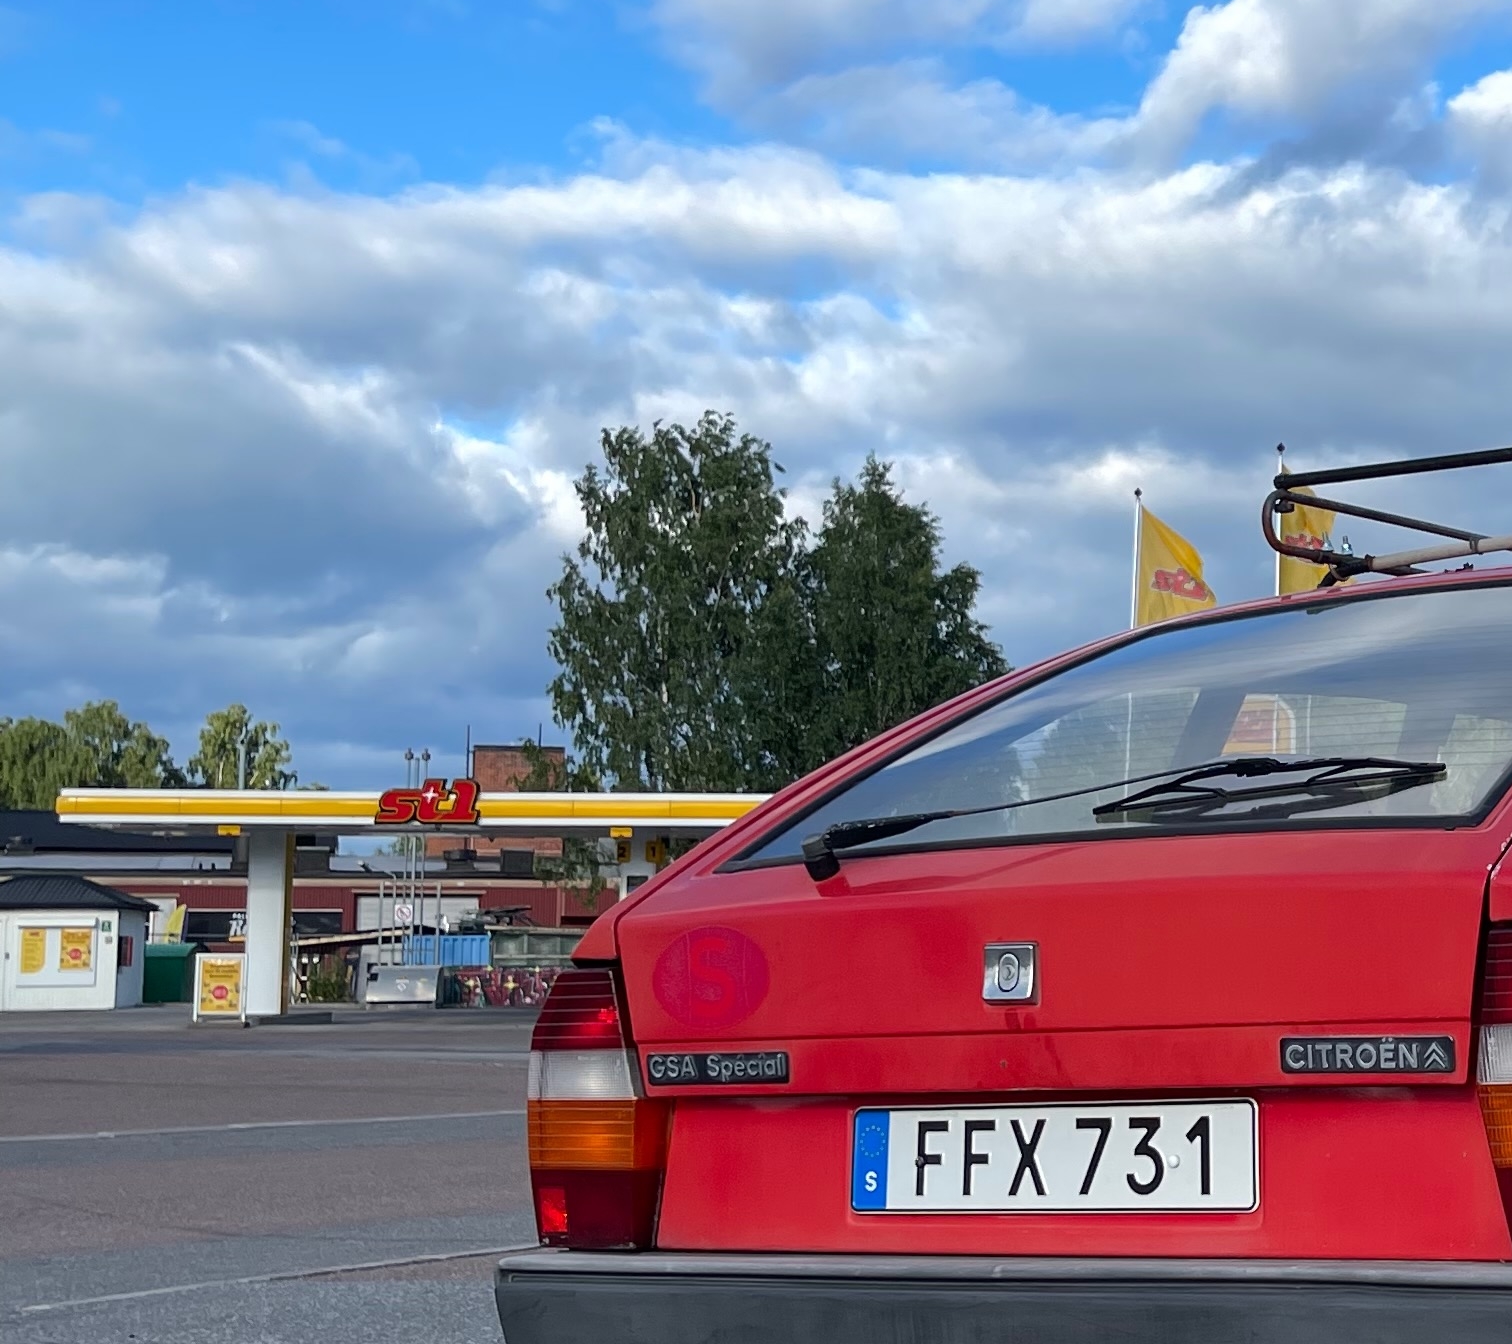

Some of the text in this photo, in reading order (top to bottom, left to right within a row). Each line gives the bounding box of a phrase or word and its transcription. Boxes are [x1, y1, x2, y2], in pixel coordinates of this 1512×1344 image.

[375, 778, 480, 824] st1
[689, 936, 736, 1018] S
[649, 1055, 697, 1078] GSA
[1285, 1037, 1419, 1069] CITROËN
[915, 1115, 1212, 1197] FFX 731
[865, 1170, 878, 1192] S
